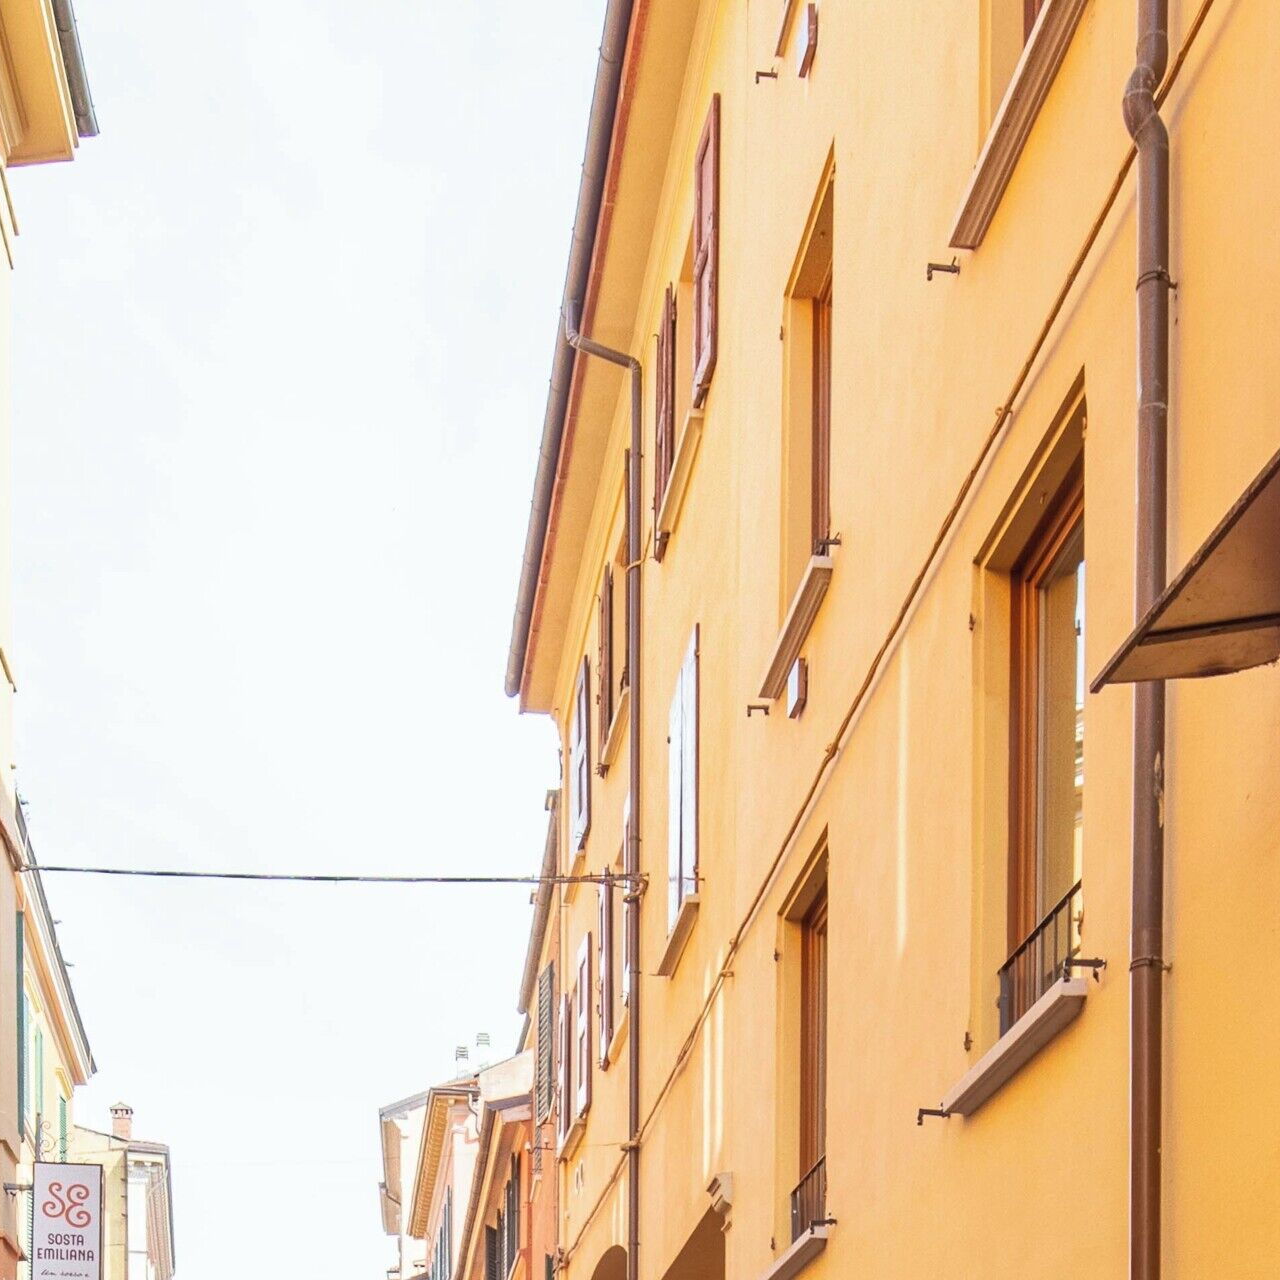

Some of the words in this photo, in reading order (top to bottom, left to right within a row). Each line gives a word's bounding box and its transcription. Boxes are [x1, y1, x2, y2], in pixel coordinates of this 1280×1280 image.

[42, 1182, 92, 1229] SE
[47, 1233, 85, 1246] SOSTA
[37, 1247, 95, 1262] EMILIANA
